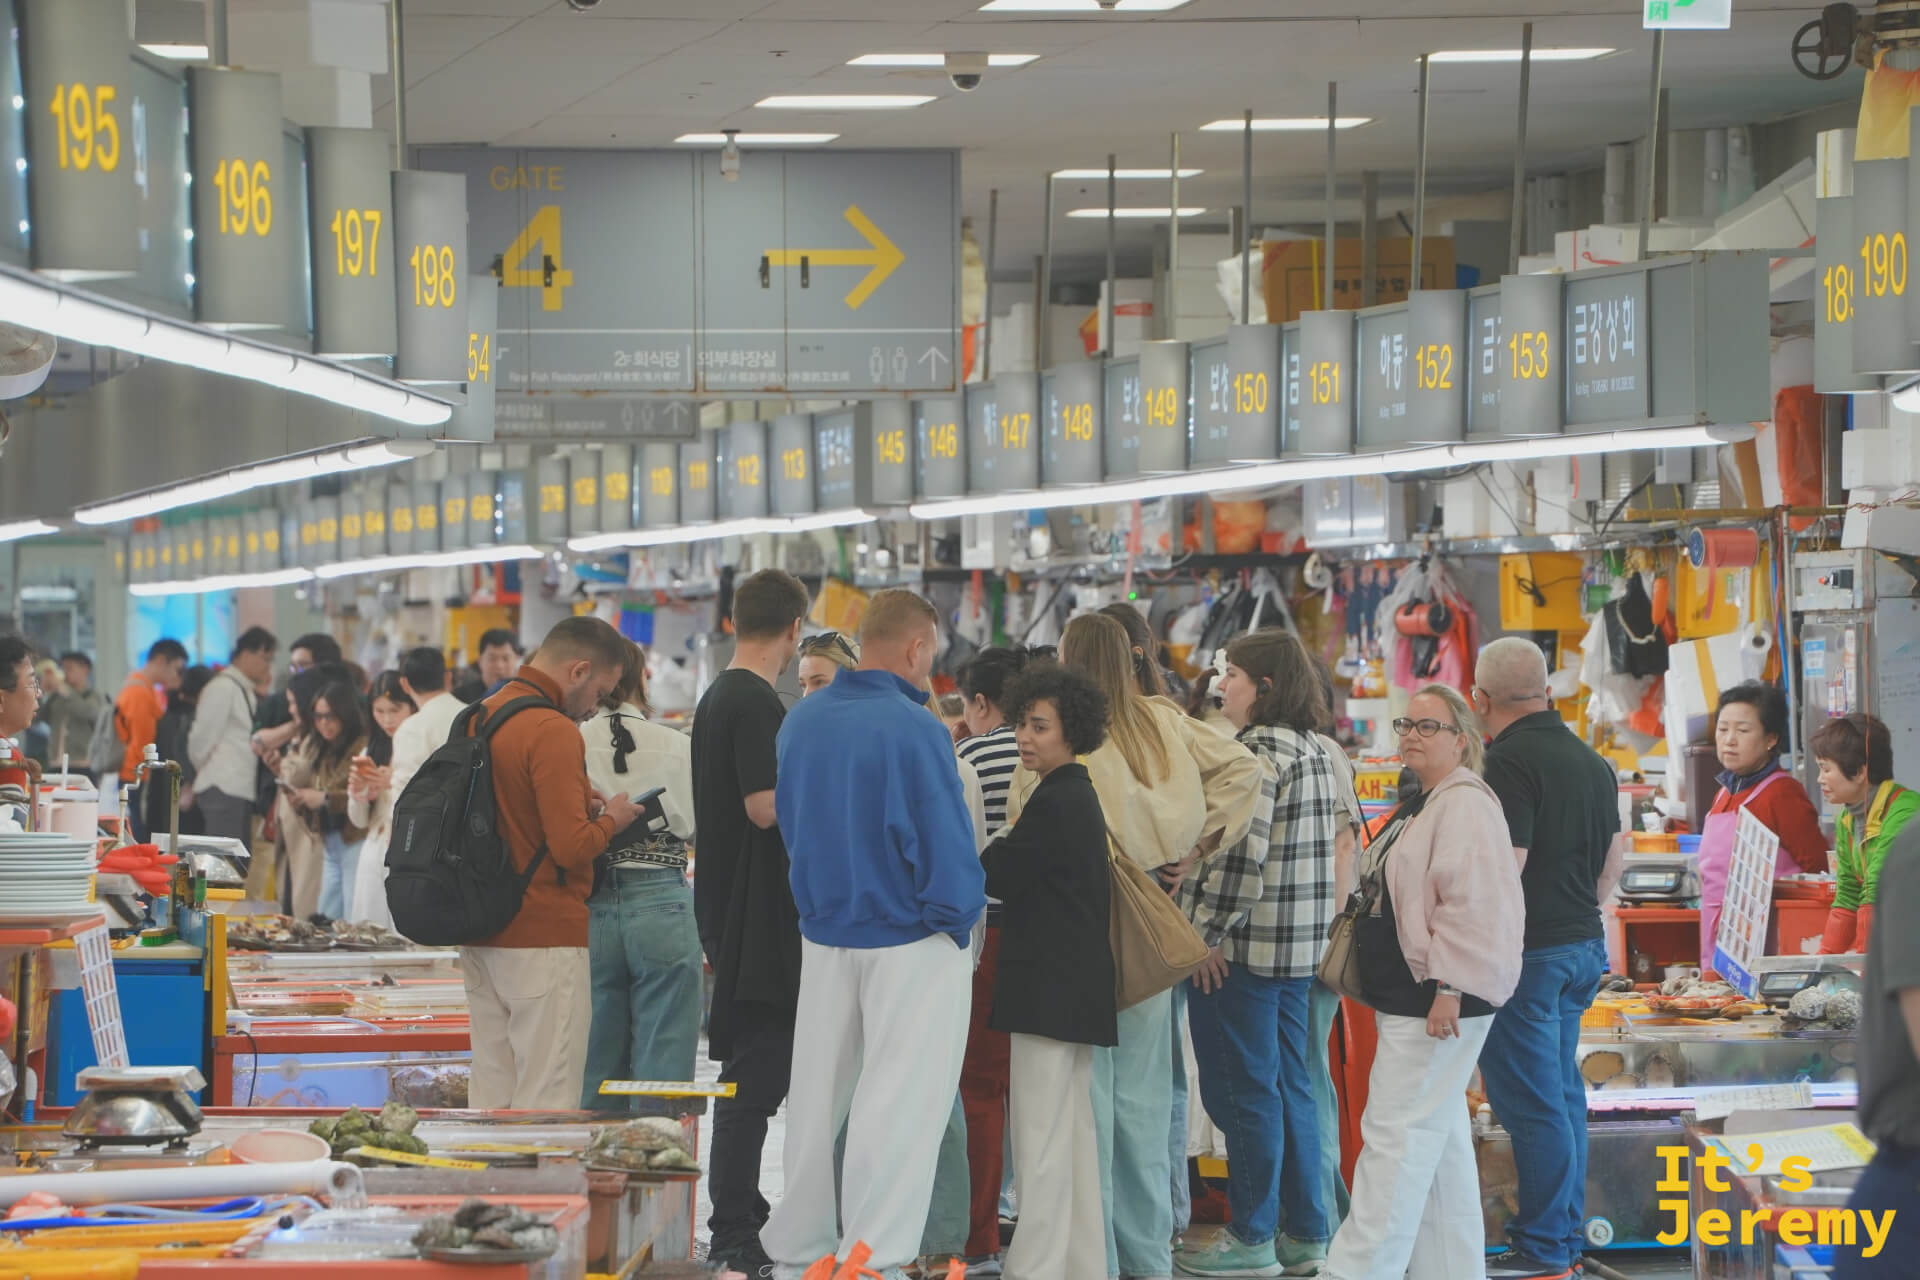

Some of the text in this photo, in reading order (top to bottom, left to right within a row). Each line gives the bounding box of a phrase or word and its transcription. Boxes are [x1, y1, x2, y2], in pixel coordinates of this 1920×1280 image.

[49, 82, 121, 173] 195
[213, 157, 273, 237] 196
[489, 165, 566, 191] GATE
[330, 208, 383, 277] 197
[491, 205, 574, 312] 4
[1860, 231, 1908, 297] 190
[409, 245, 456, 308] 198
[1823, 264, 1854, 323] 18
[1575, 295, 1636, 364] 금강상회
[467, 333, 490, 384] 54
[697, 350, 777, 368] 외부화장실
[1415, 344, 1453, 390] 152
[1508, 331, 1550, 379] 153
[1232, 372, 1268, 414] 150
[1309, 361, 1340, 404] 151
[1062, 403, 1094, 441] 148
[1144, 387, 1178, 427] 149
[876, 429, 905, 465] 145
[928, 423, 958, 459] 146
[1000, 413, 1031, 449] 147
[737, 455, 760, 486] 112
[782, 448, 806, 480] 113
